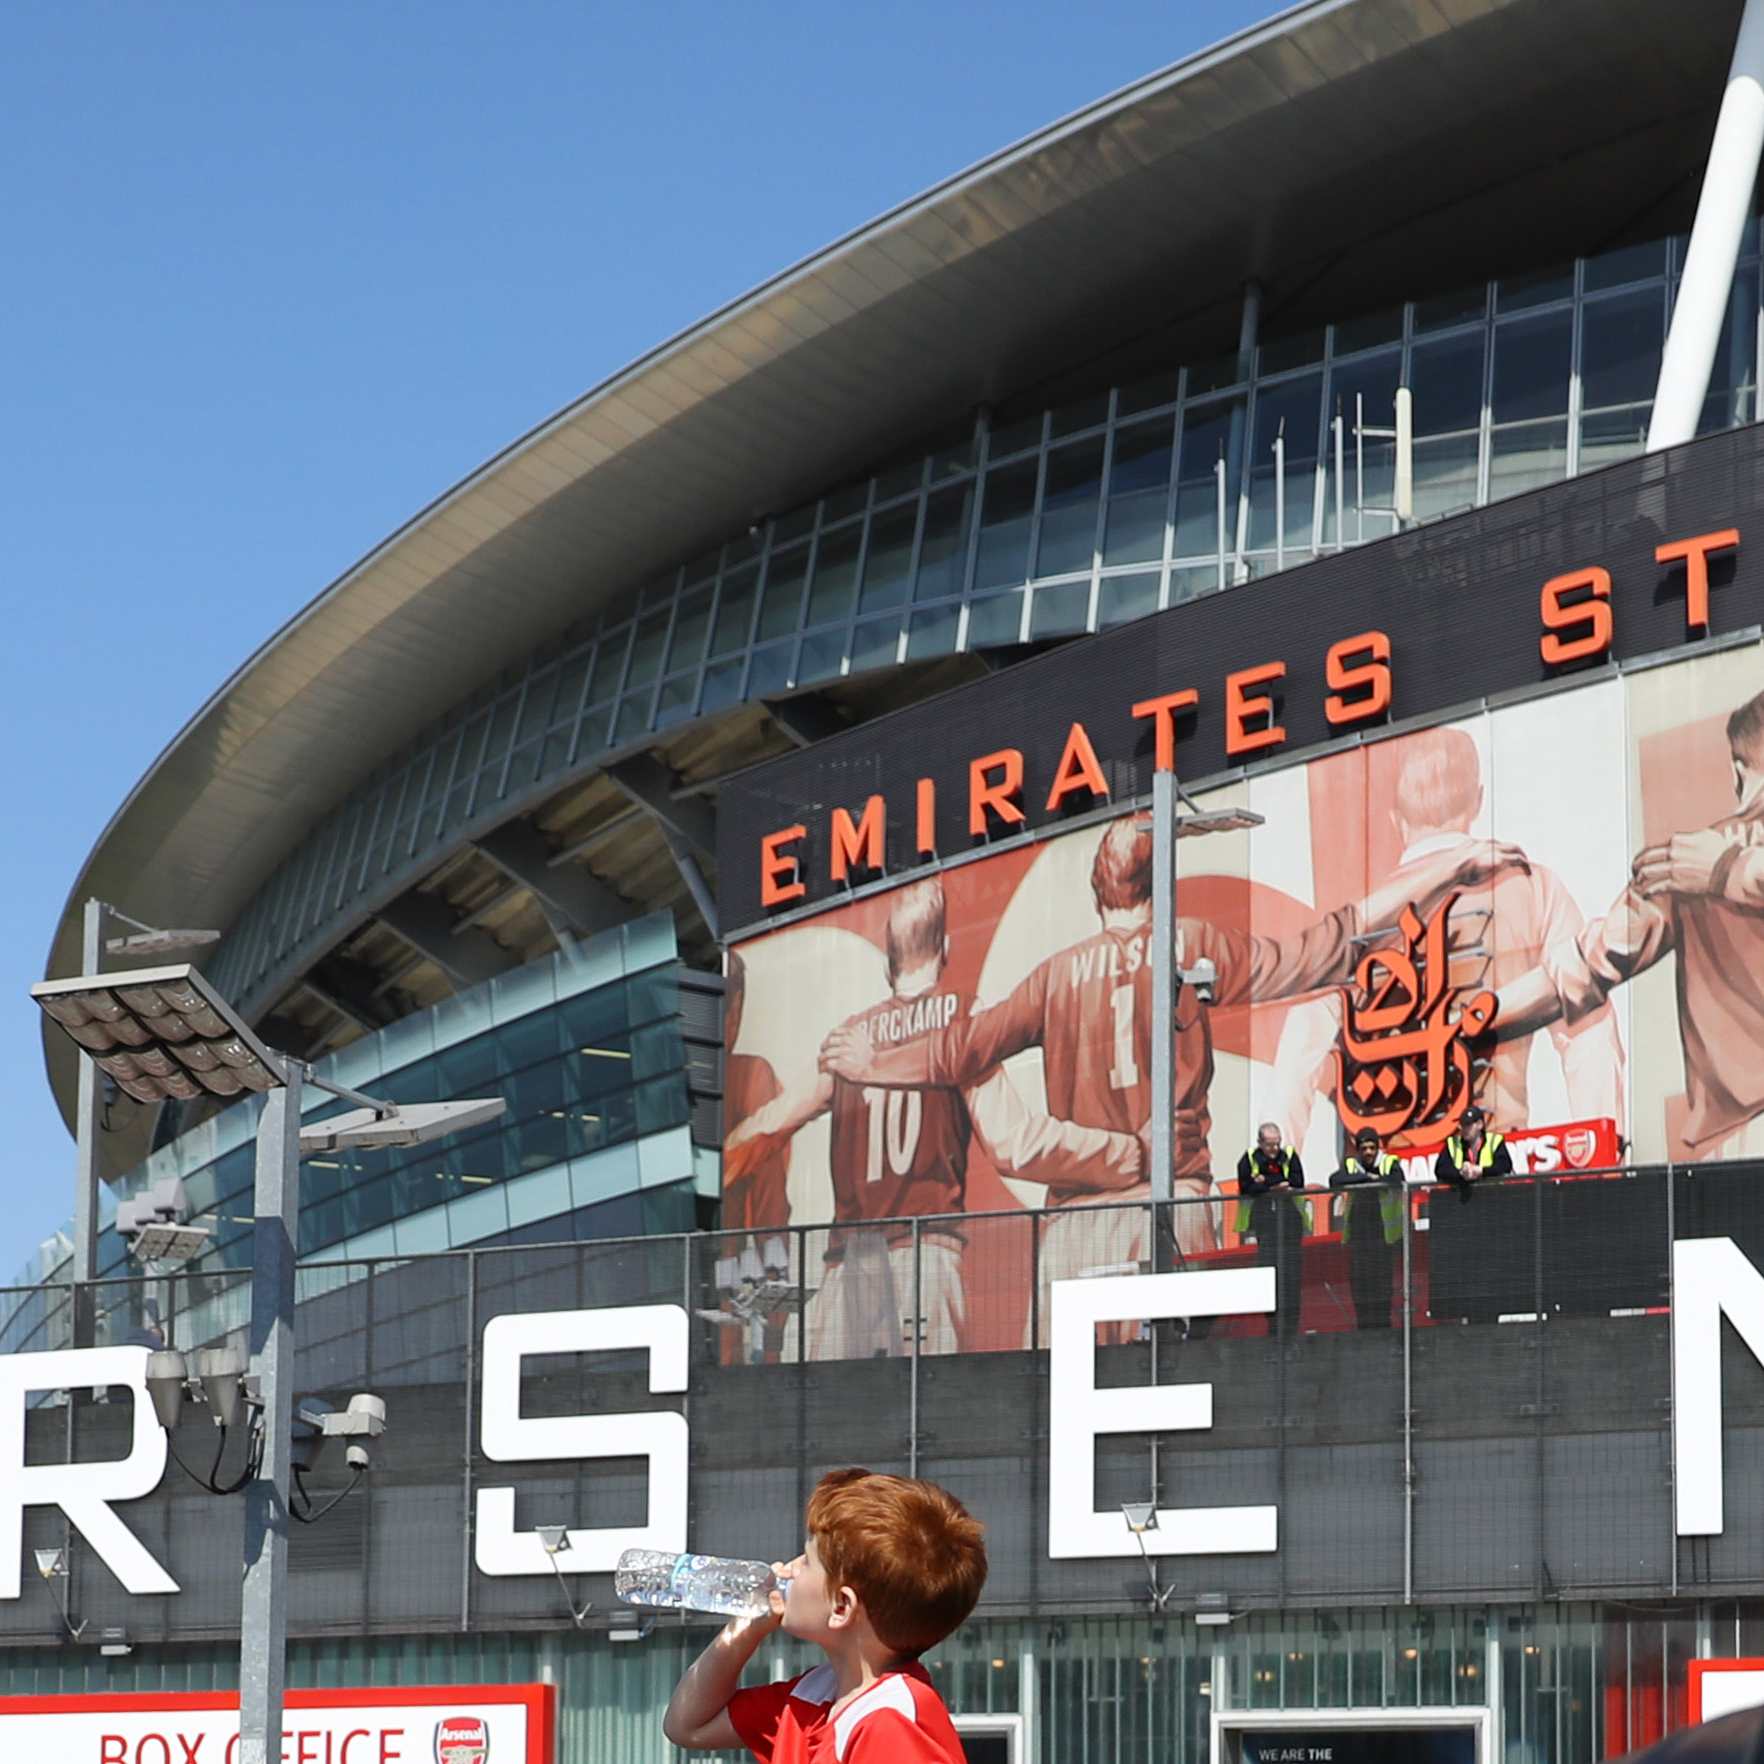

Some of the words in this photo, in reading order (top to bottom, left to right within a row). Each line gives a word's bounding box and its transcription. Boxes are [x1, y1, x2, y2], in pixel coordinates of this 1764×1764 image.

[760, 631, 1391, 907] EMIRATES
[863, 1087, 922, 1183] 10
[440, 1727, 483, 1742] Arsenal
[1258, 1748, 1278, 1761] WE
[1280, 1748, 1305, 1761] ARE
[1308, 1747, 1333, 1760] THE
